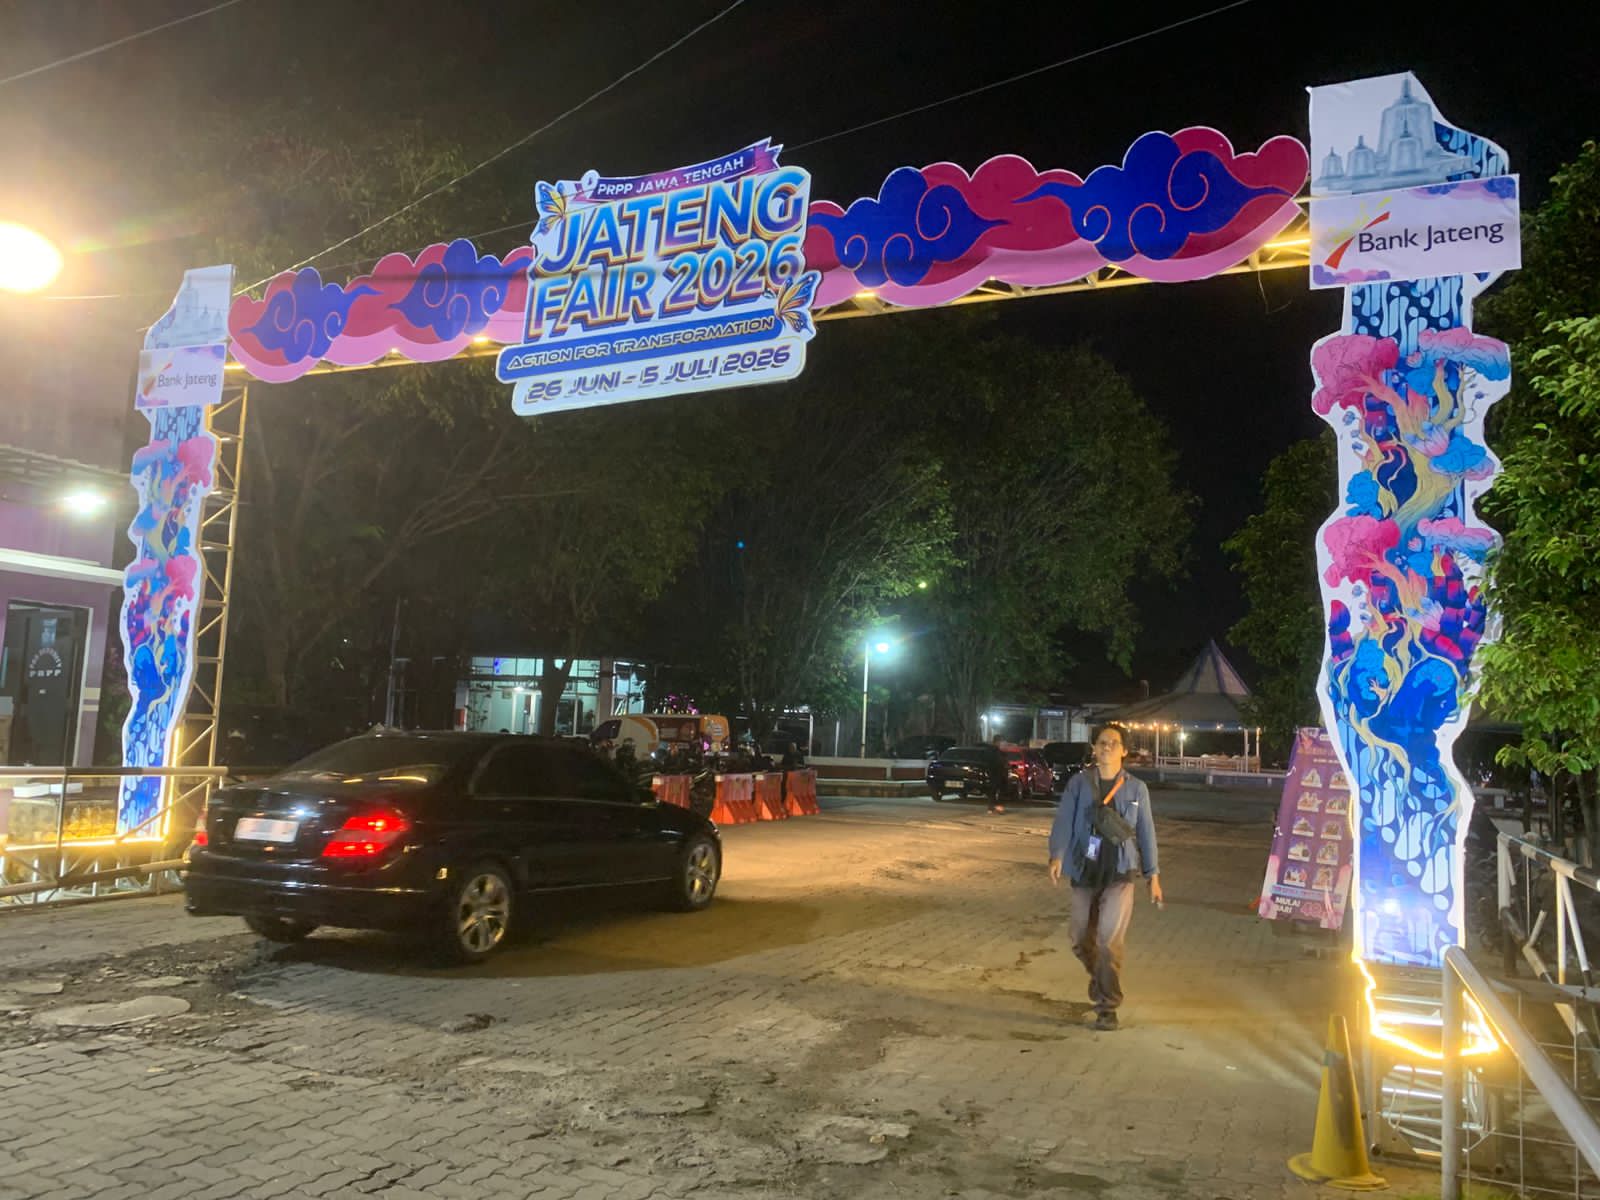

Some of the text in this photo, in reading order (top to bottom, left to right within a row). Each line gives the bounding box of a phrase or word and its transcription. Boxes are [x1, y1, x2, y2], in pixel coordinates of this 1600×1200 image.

[597, 156, 745, 196] PRPP JAWA TENGAH
[534, 168, 806, 276] JATENG
[1358, 222, 1505, 253] Bank Jateng
[526, 234, 804, 342] FAIR 2026
[506, 315, 775, 371] ACTION FOR TRANSFORMATION
[157, 373, 217, 390] Bank Jateng
[525, 379, 563, 403] 26
[568, 369, 621, 395] JUNI
[640, 365, 660, 386] 5
[661, 355, 720, 383] JULI
[720, 345, 792, 375] 2026
